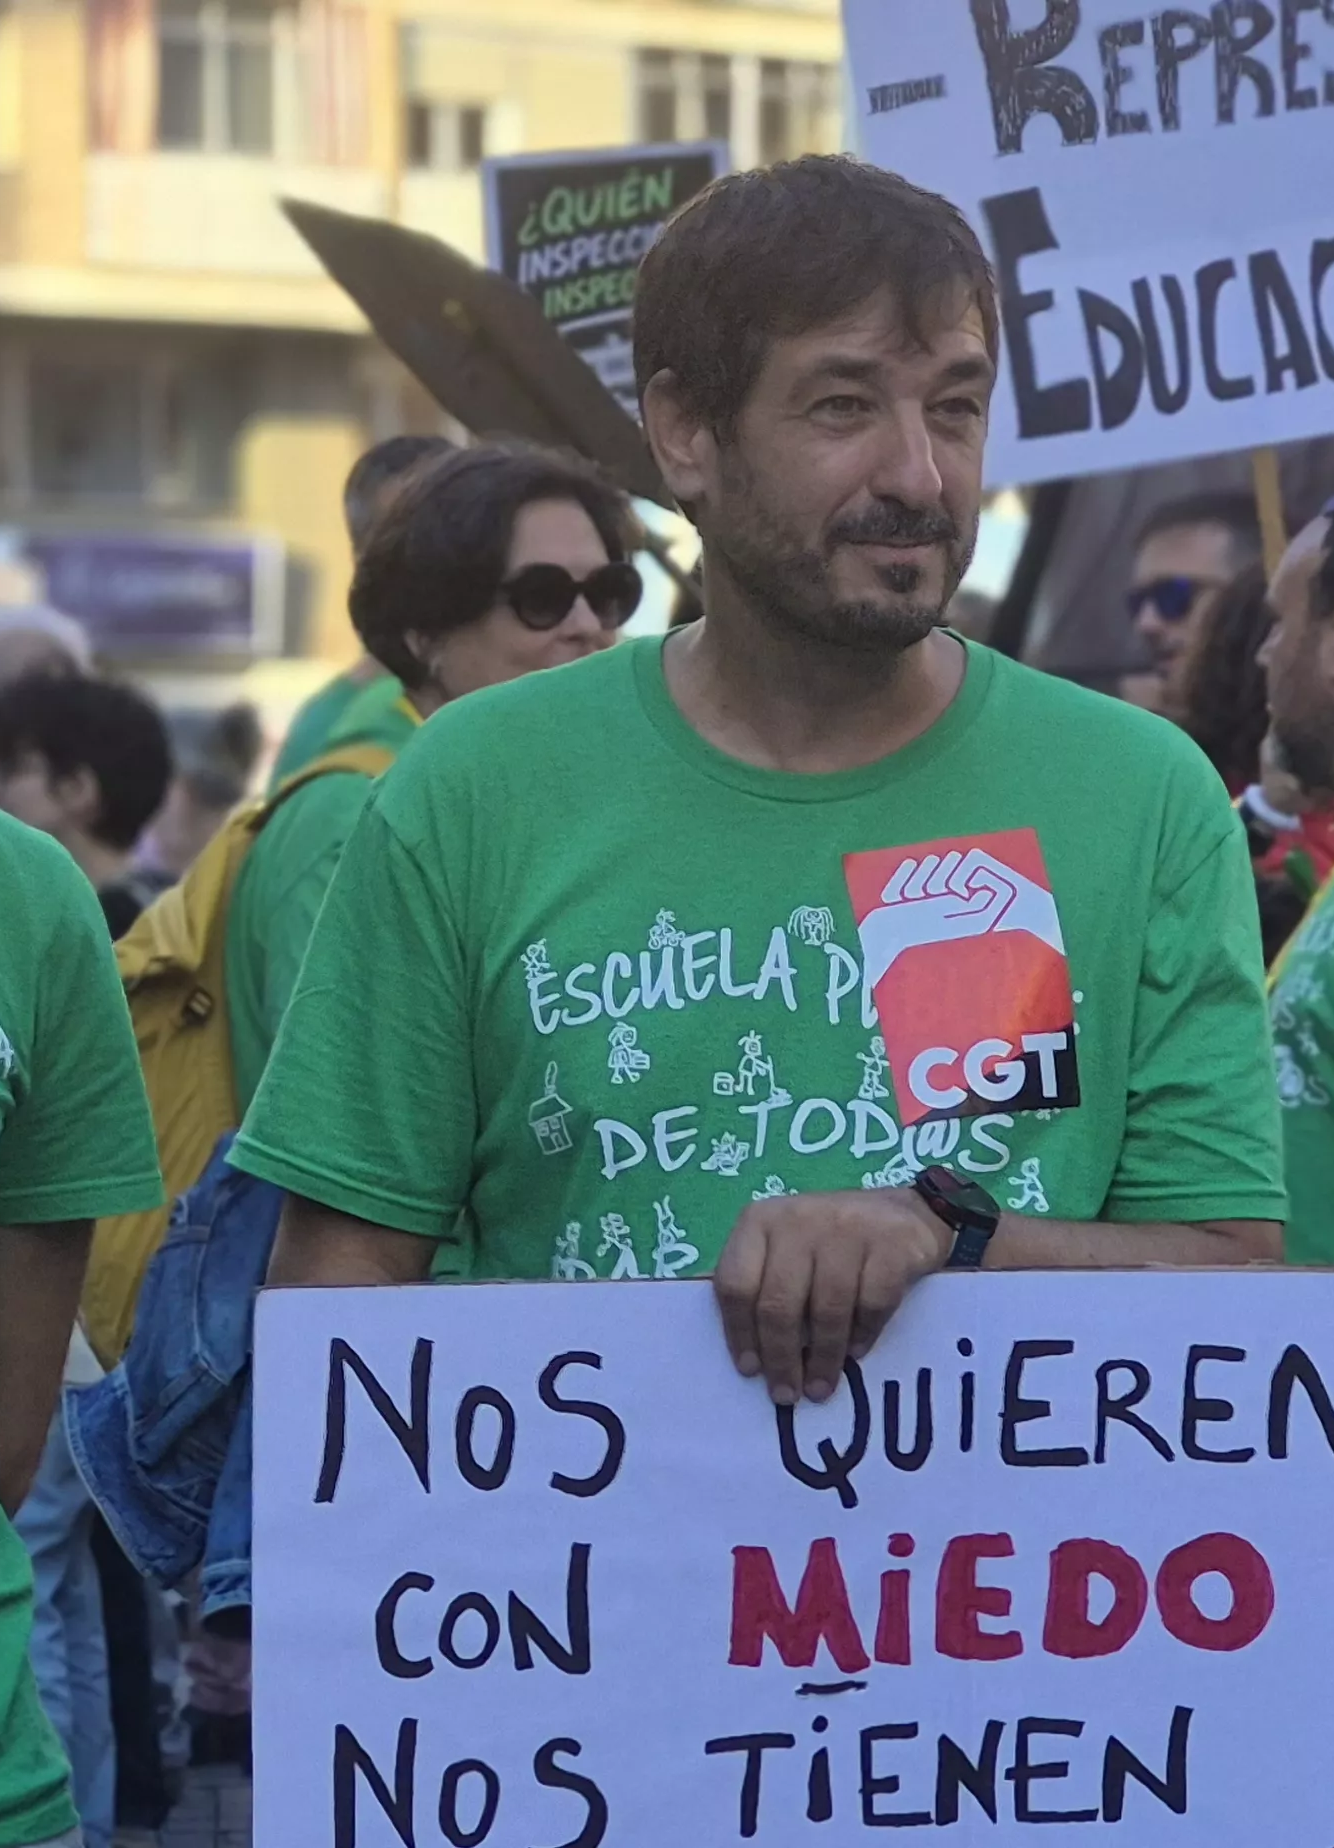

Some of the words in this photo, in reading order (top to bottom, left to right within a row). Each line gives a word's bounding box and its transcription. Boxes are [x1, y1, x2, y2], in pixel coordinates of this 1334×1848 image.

[527, 926, 797, 1034] ESCUELA
[908, 1031, 1067, 1109] CGT
[594, 1105, 697, 1180] DE
[375, 1542, 591, 1679] CON
